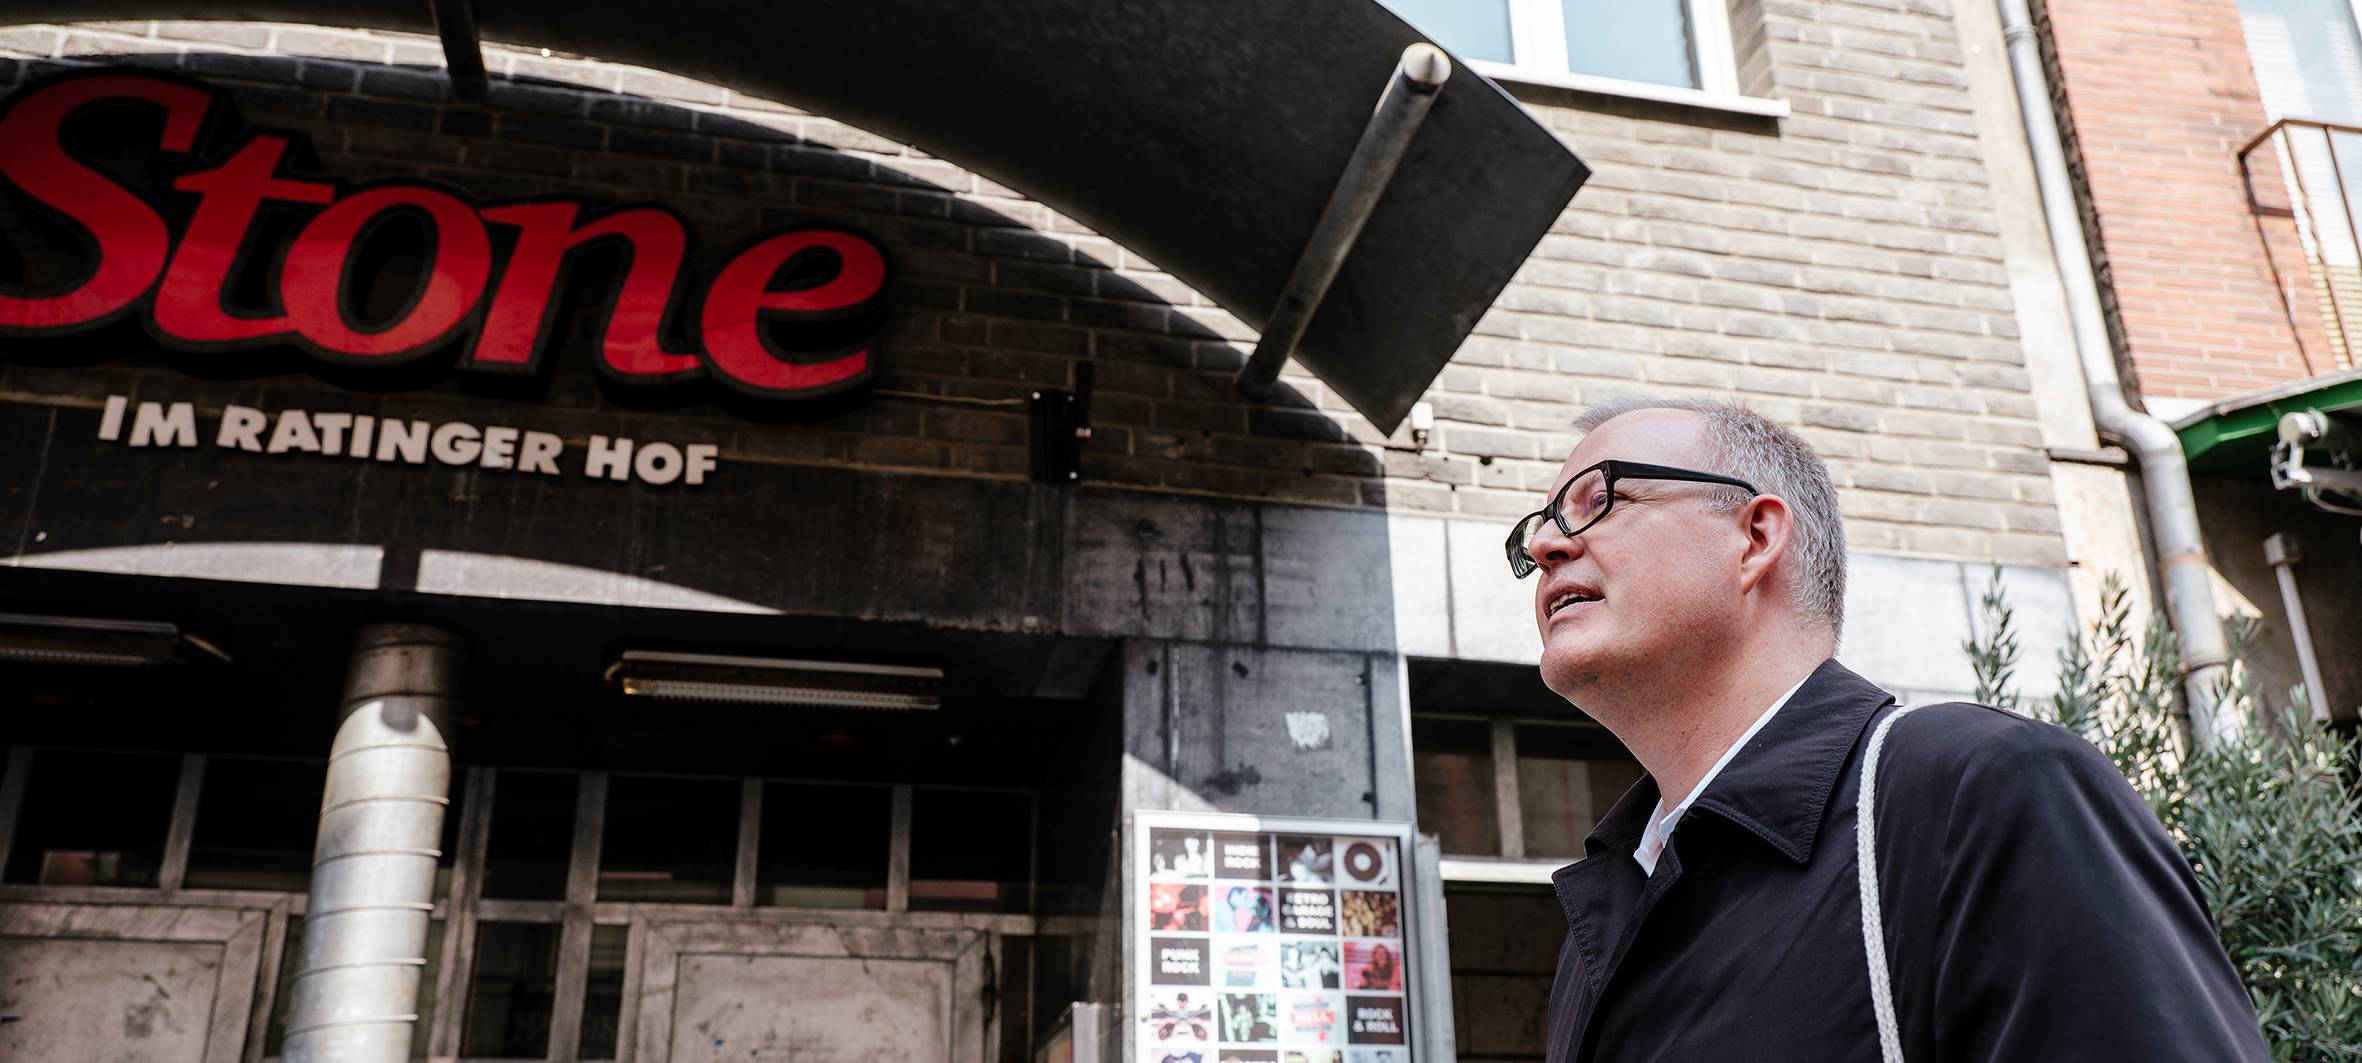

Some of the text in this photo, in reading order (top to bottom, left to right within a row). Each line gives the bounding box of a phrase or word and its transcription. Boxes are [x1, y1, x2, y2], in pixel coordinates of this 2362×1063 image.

[0, 74, 887, 391] Stone
[99, 396, 718, 485] IM RATINGER HOF
[1224, 856, 1261, 869] ROCK
[1297, 916, 1333, 930] SOUL
[1161, 948, 1200, 961] PUNK
[1161, 960, 1200, 974] ROCK
[1357, 1008, 1393, 1020] ROCK
[1353, 1020, 1400, 1033] & ROLL
